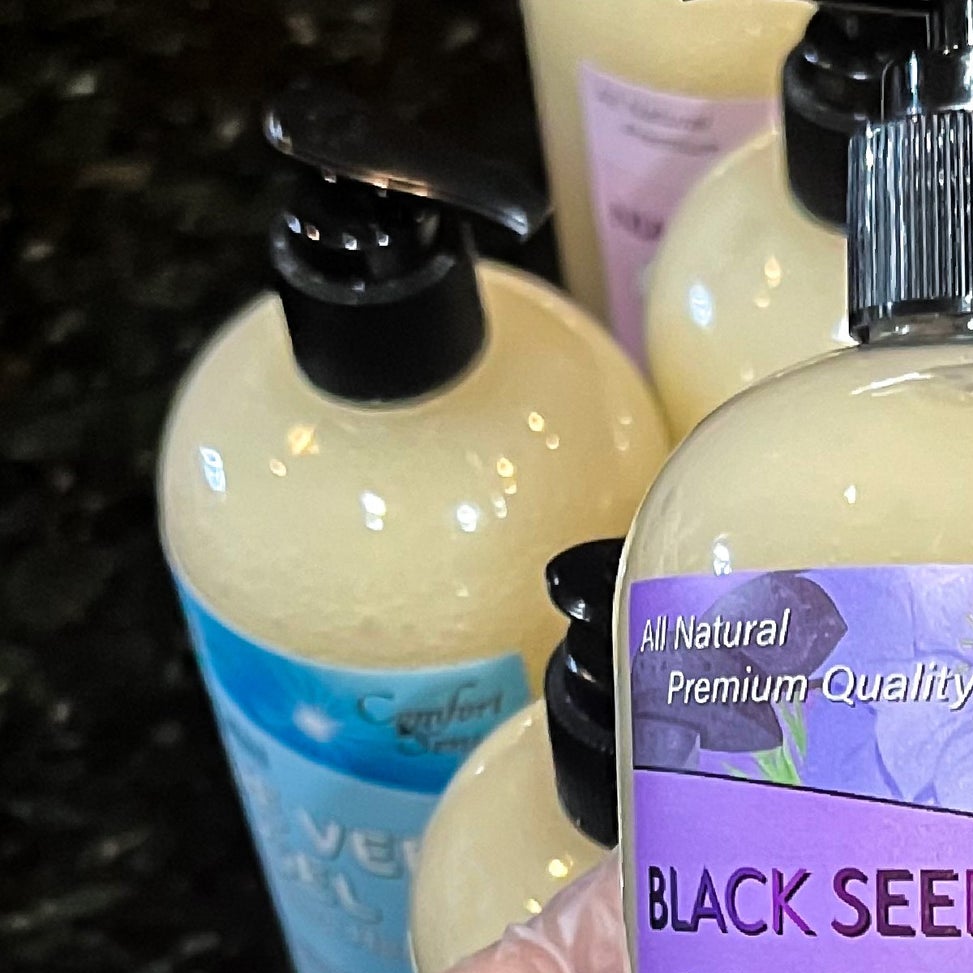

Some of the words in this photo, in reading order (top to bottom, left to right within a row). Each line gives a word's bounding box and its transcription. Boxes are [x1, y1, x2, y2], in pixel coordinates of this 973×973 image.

[640, 616, 668, 653] All
[674, 608, 791, 651] Natural
[667, 666, 808, 705] Premium
[648, 865, 818, 939] BLACK
